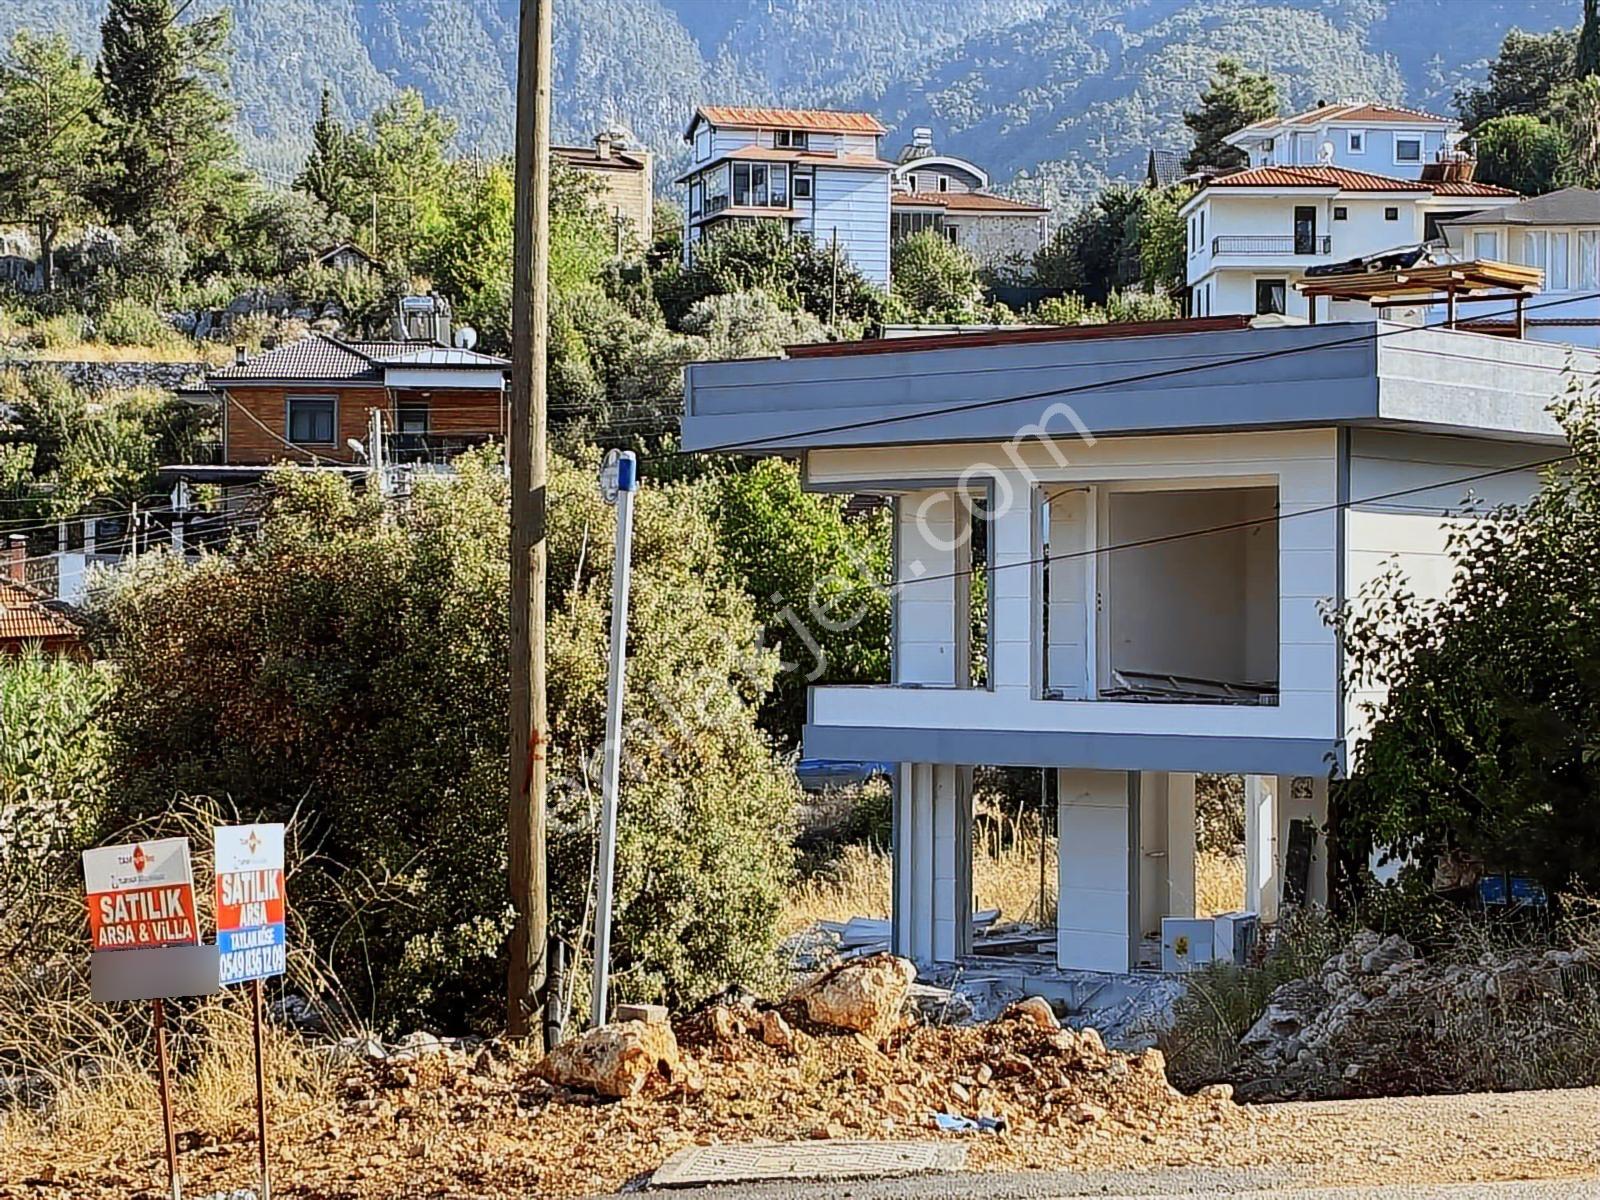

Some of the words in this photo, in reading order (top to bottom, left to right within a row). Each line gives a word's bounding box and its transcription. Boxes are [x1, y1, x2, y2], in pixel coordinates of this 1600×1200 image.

[222, 869, 280, 906] SATILIK
[100, 889, 184, 924] SATILIK
[239, 901, 267, 927] ARSA
[98, 924, 136, 946] ARSA
[139, 922, 150, 942] &
[220, 951, 244, 981] 0549
